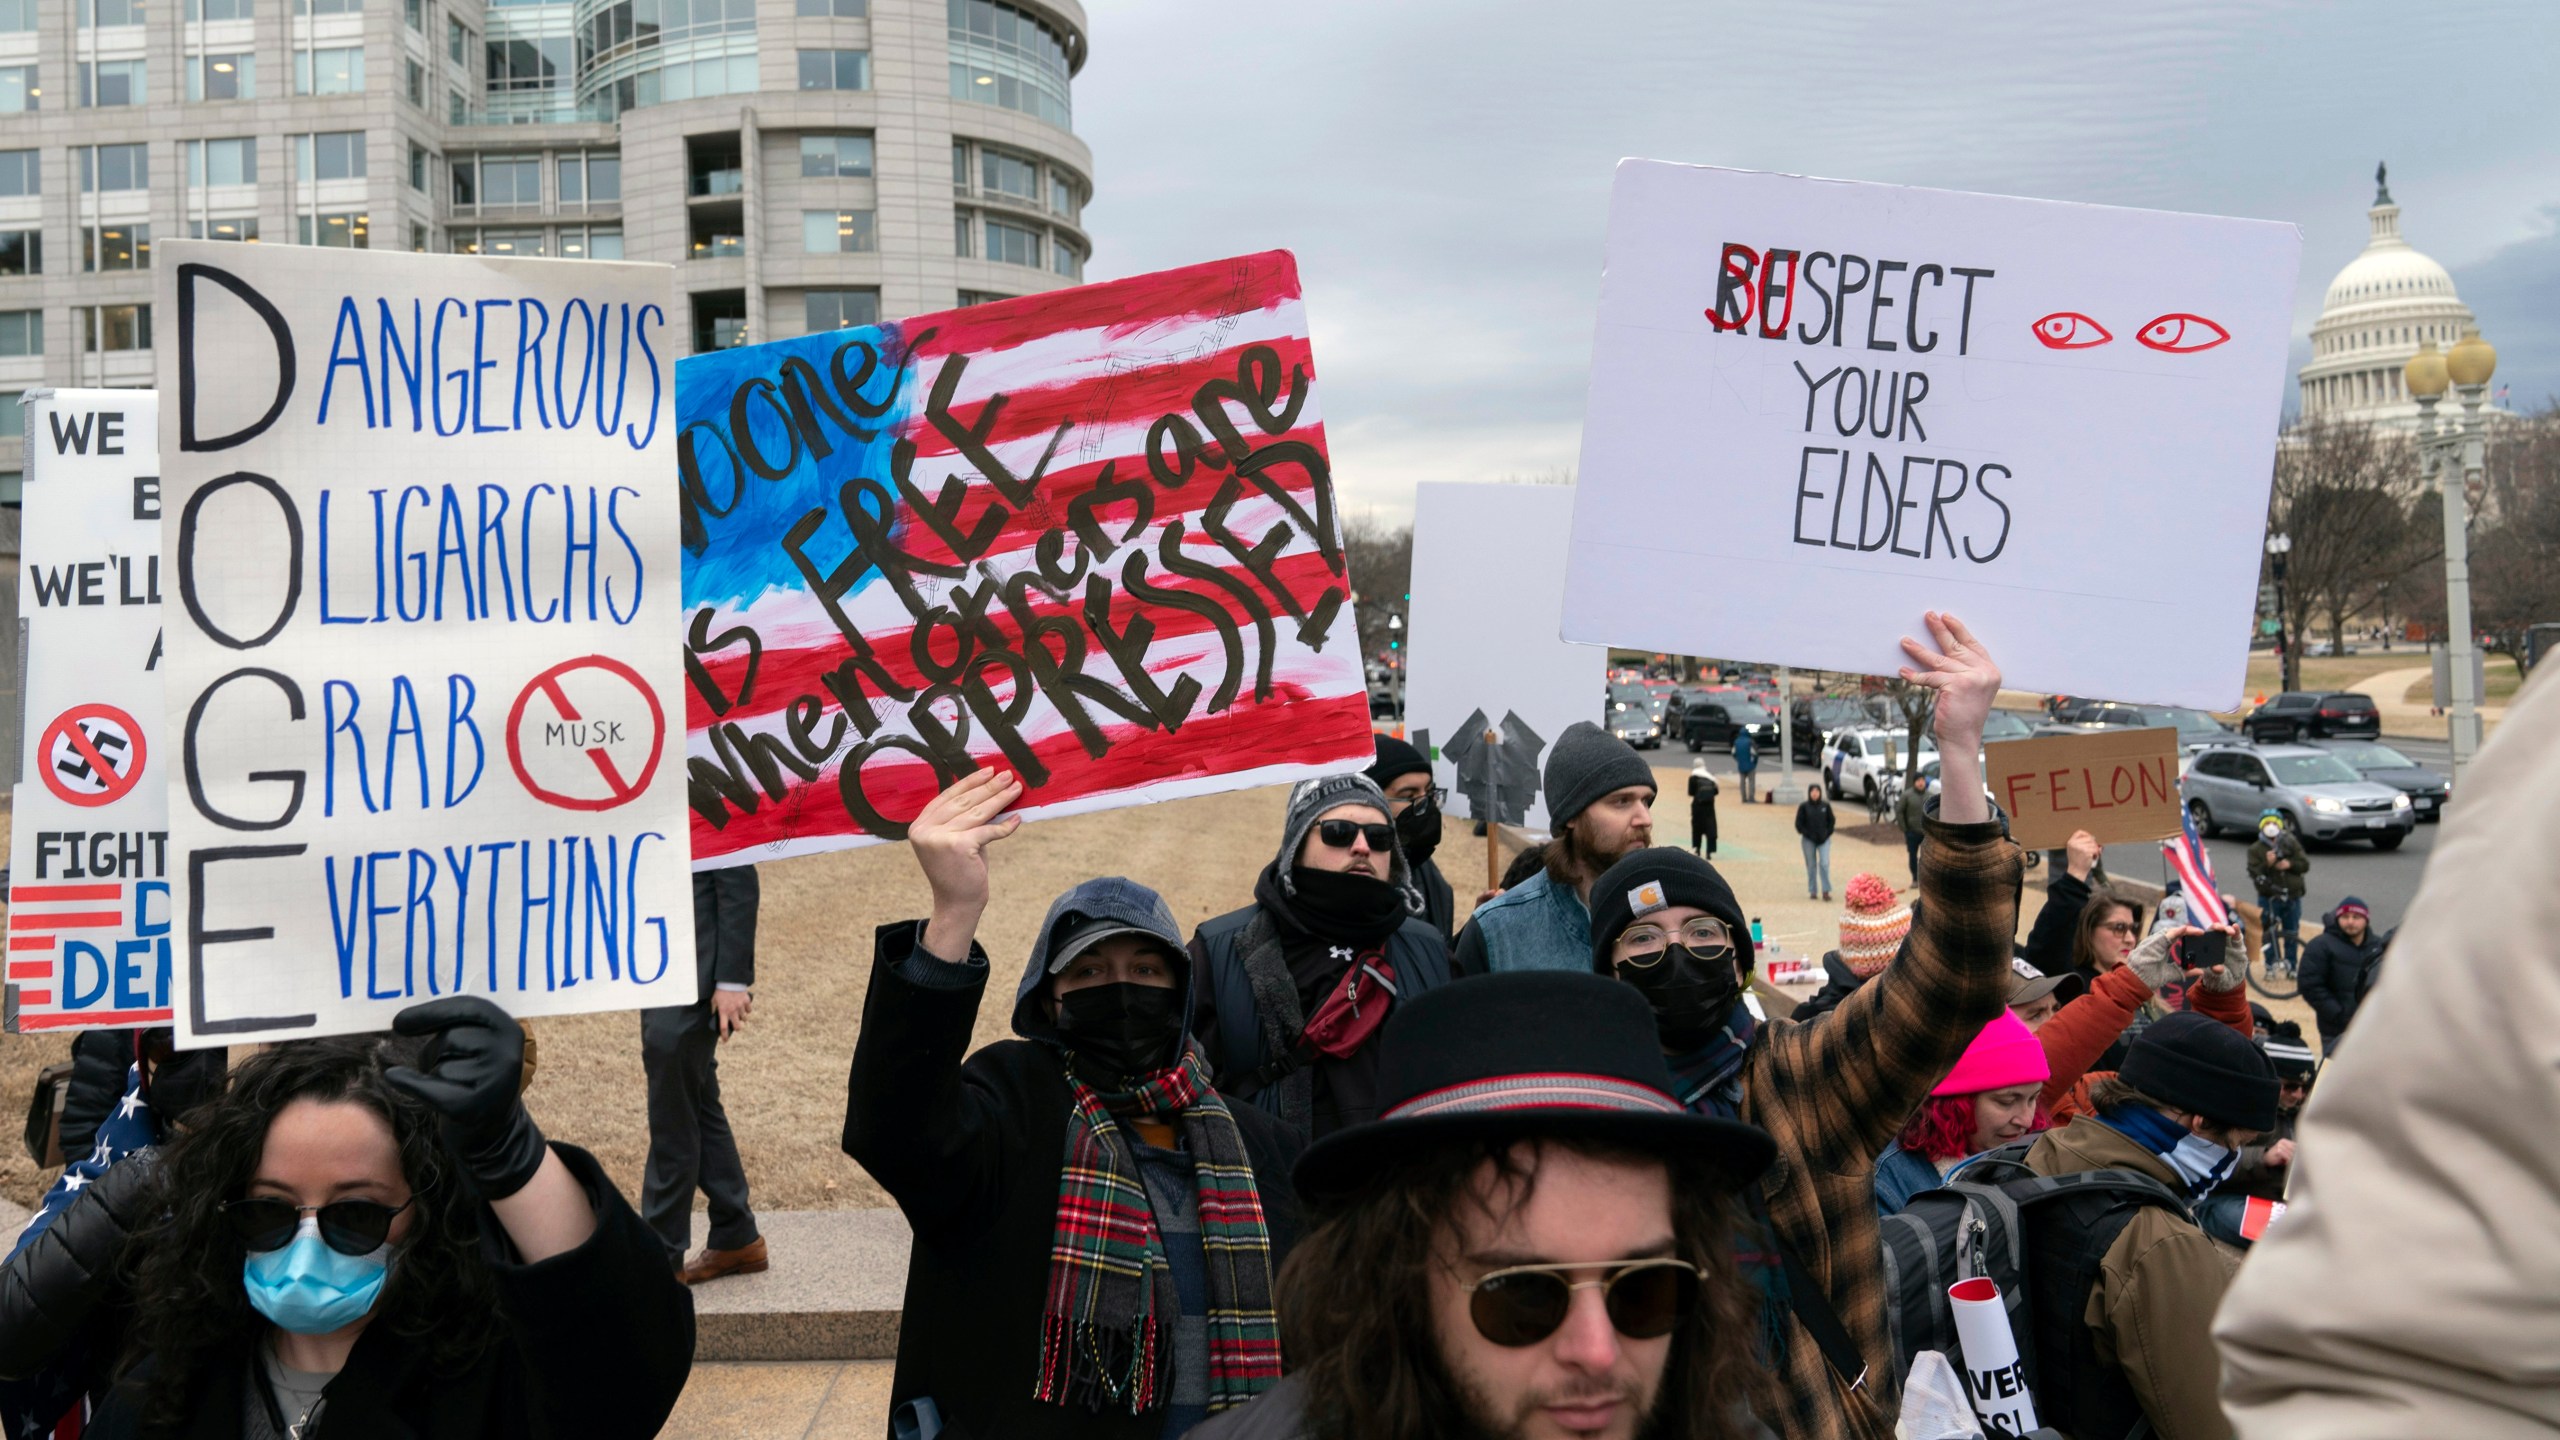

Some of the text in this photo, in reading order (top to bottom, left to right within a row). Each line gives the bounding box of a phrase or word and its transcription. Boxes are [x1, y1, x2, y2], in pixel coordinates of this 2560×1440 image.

[49, 411, 124, 455] WE
[1144, 345, 1308, 488] are
[1794, 359, 1930, 443] YOUR
[781, 352, 1076, 656] FREE
[1793, 447, 2012, 564] ELDERS
[30, 554, 162, 607] WE'LL
[838, 439, 1346, 841] OPPRESSED
[545, 720, 625, 747] MUSK
[36, 831, 168, 879] FIGHT
